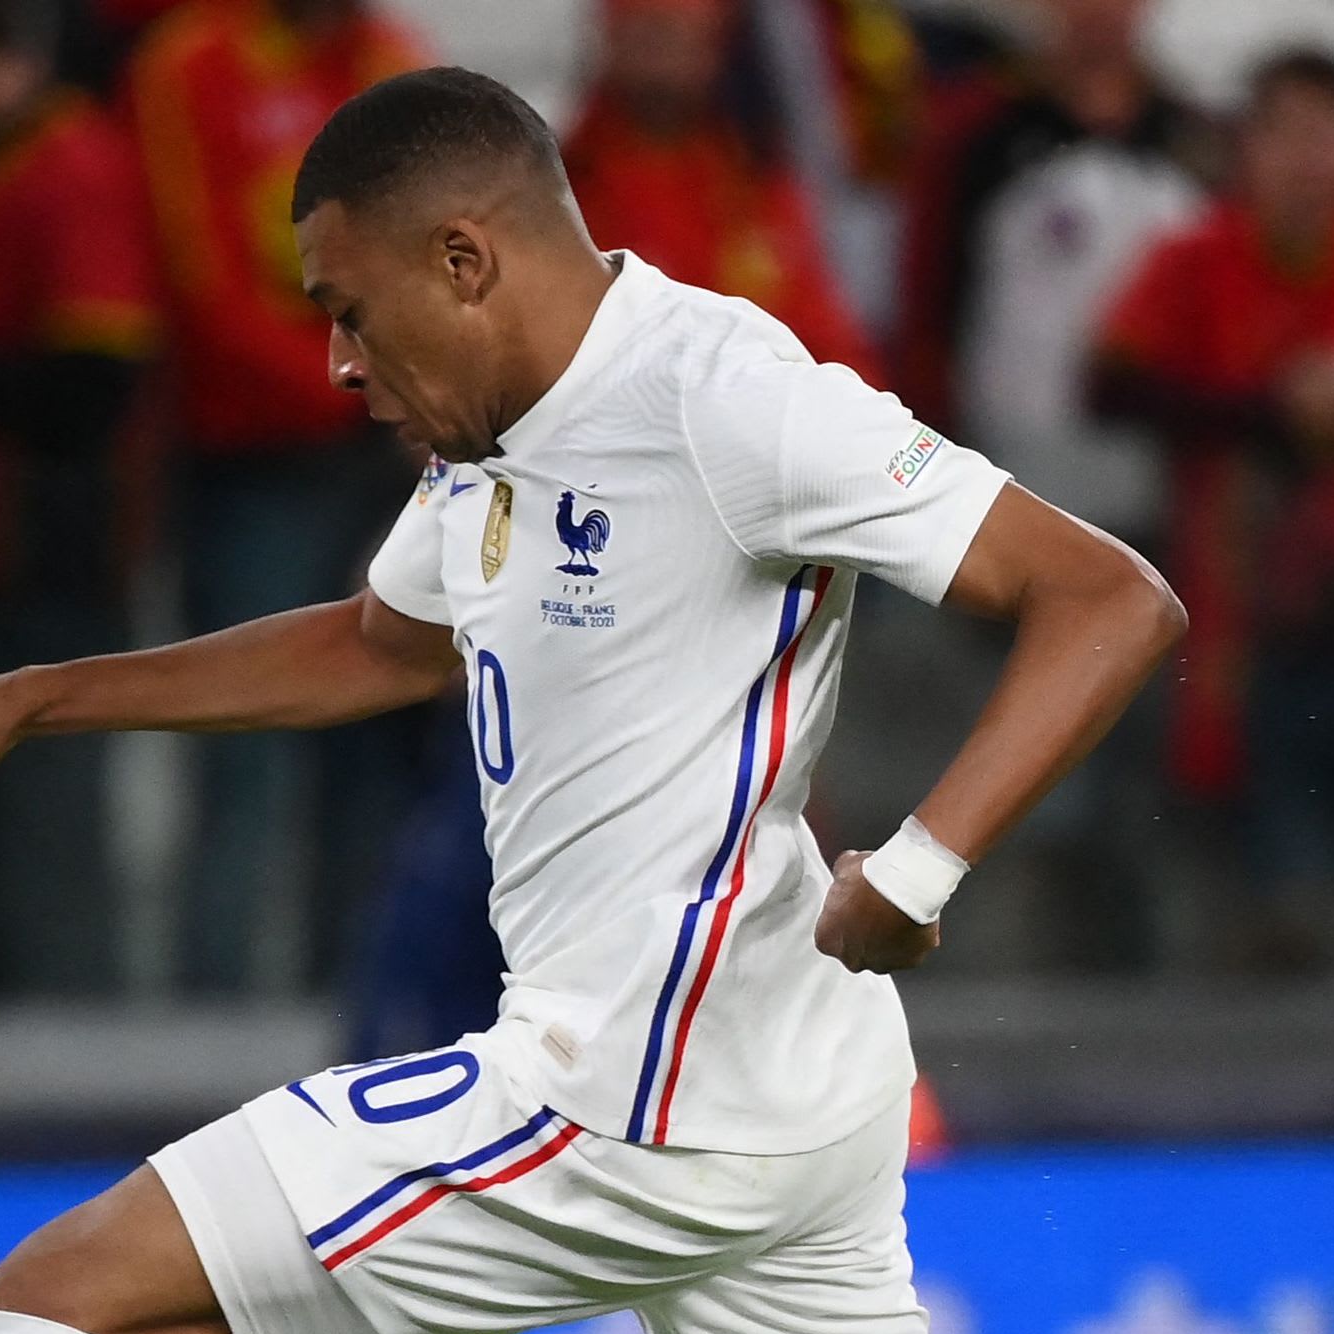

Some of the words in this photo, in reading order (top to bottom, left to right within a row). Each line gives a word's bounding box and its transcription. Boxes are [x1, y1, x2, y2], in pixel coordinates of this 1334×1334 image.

[885, 450, 906, 474] UEFA
[542, 612, 549, 623] 7
[550, 614, 587, 627] OCTOBRE
[589, 617, 615, 627] 2021
[582, 605, 616, 615] FRANCE
[464, 633, 515, 785] 0
[329, 1050, 480, 1124] 0
